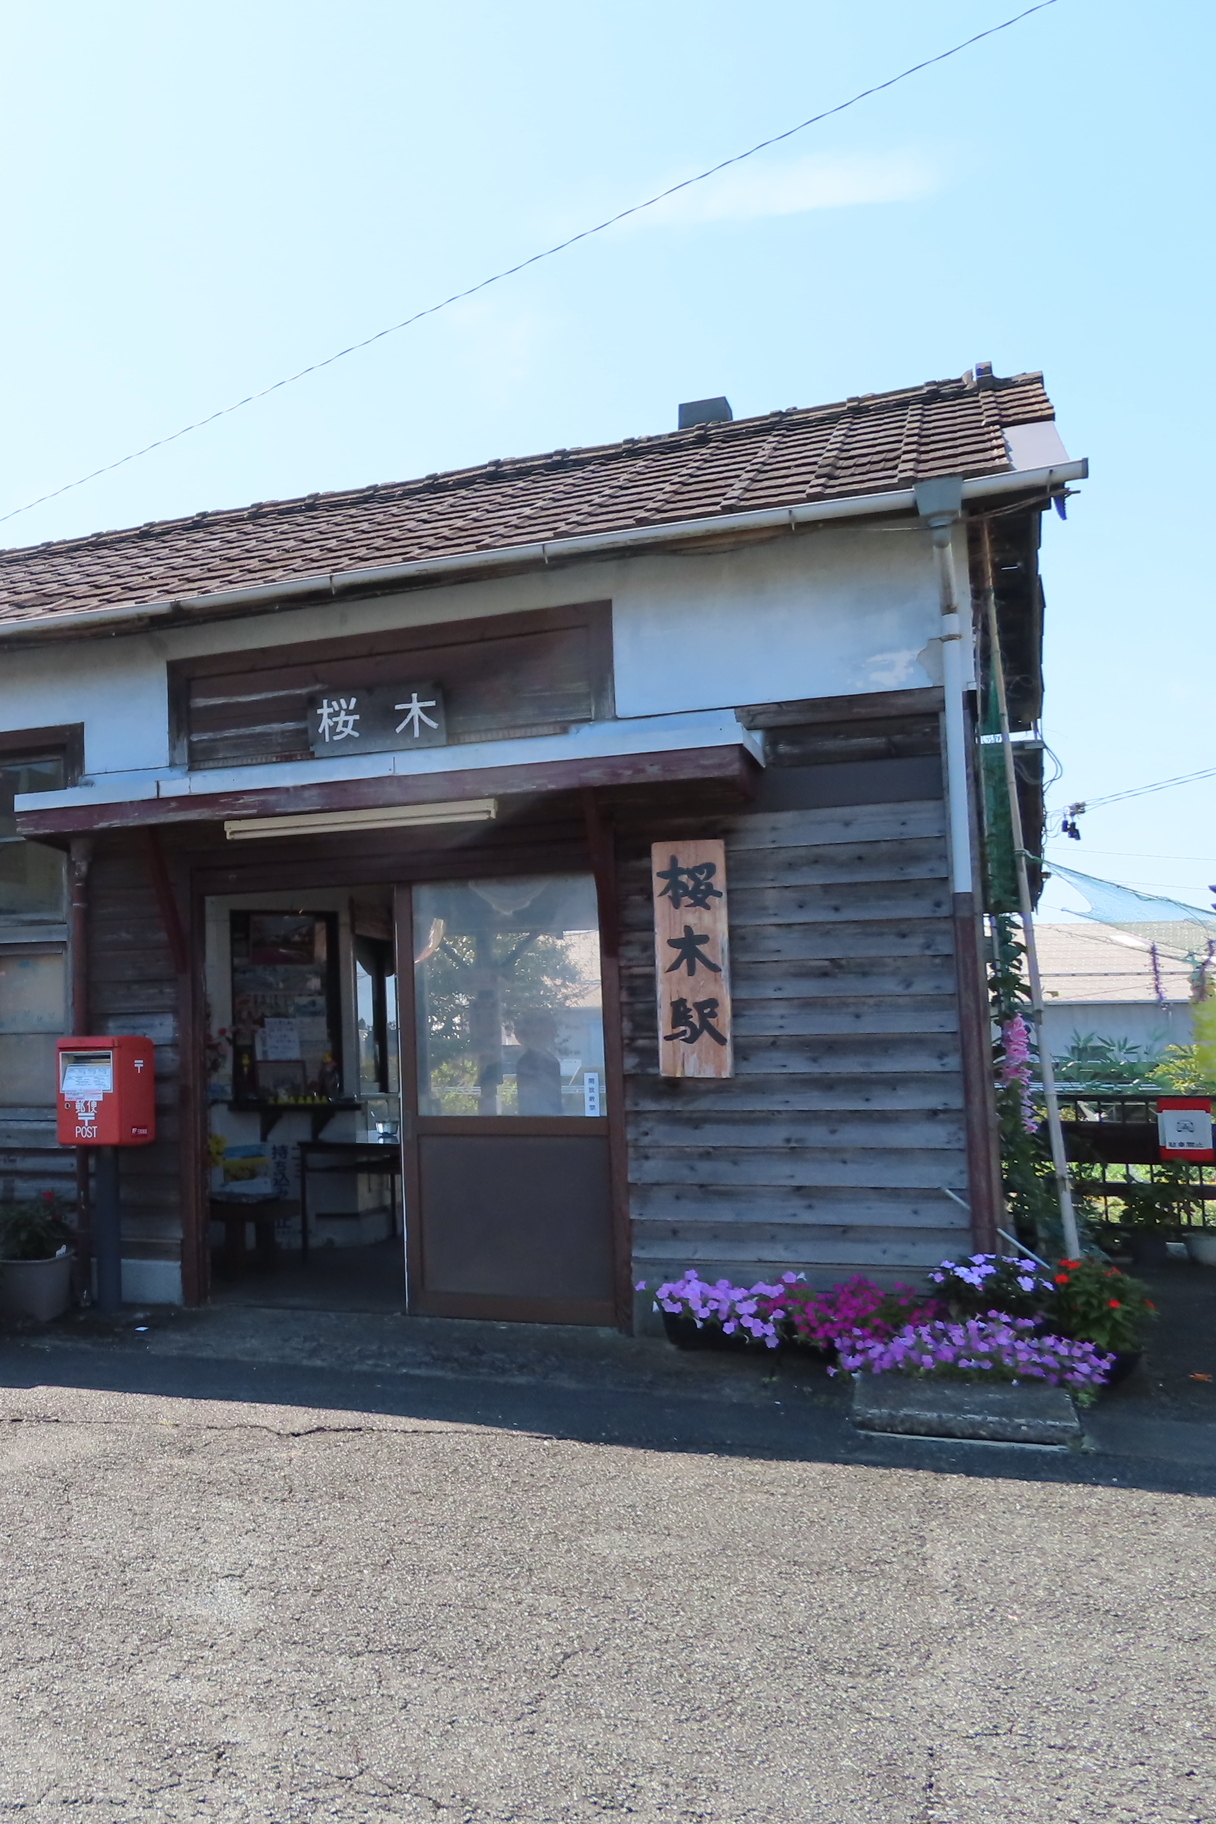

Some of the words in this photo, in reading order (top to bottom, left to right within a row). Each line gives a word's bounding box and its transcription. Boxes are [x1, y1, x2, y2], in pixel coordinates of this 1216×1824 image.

[317, 693, 439, 742] 桜木
[75, 1100, 98, 1114] 郵便
[75, 1126, 98, 1138] POST
